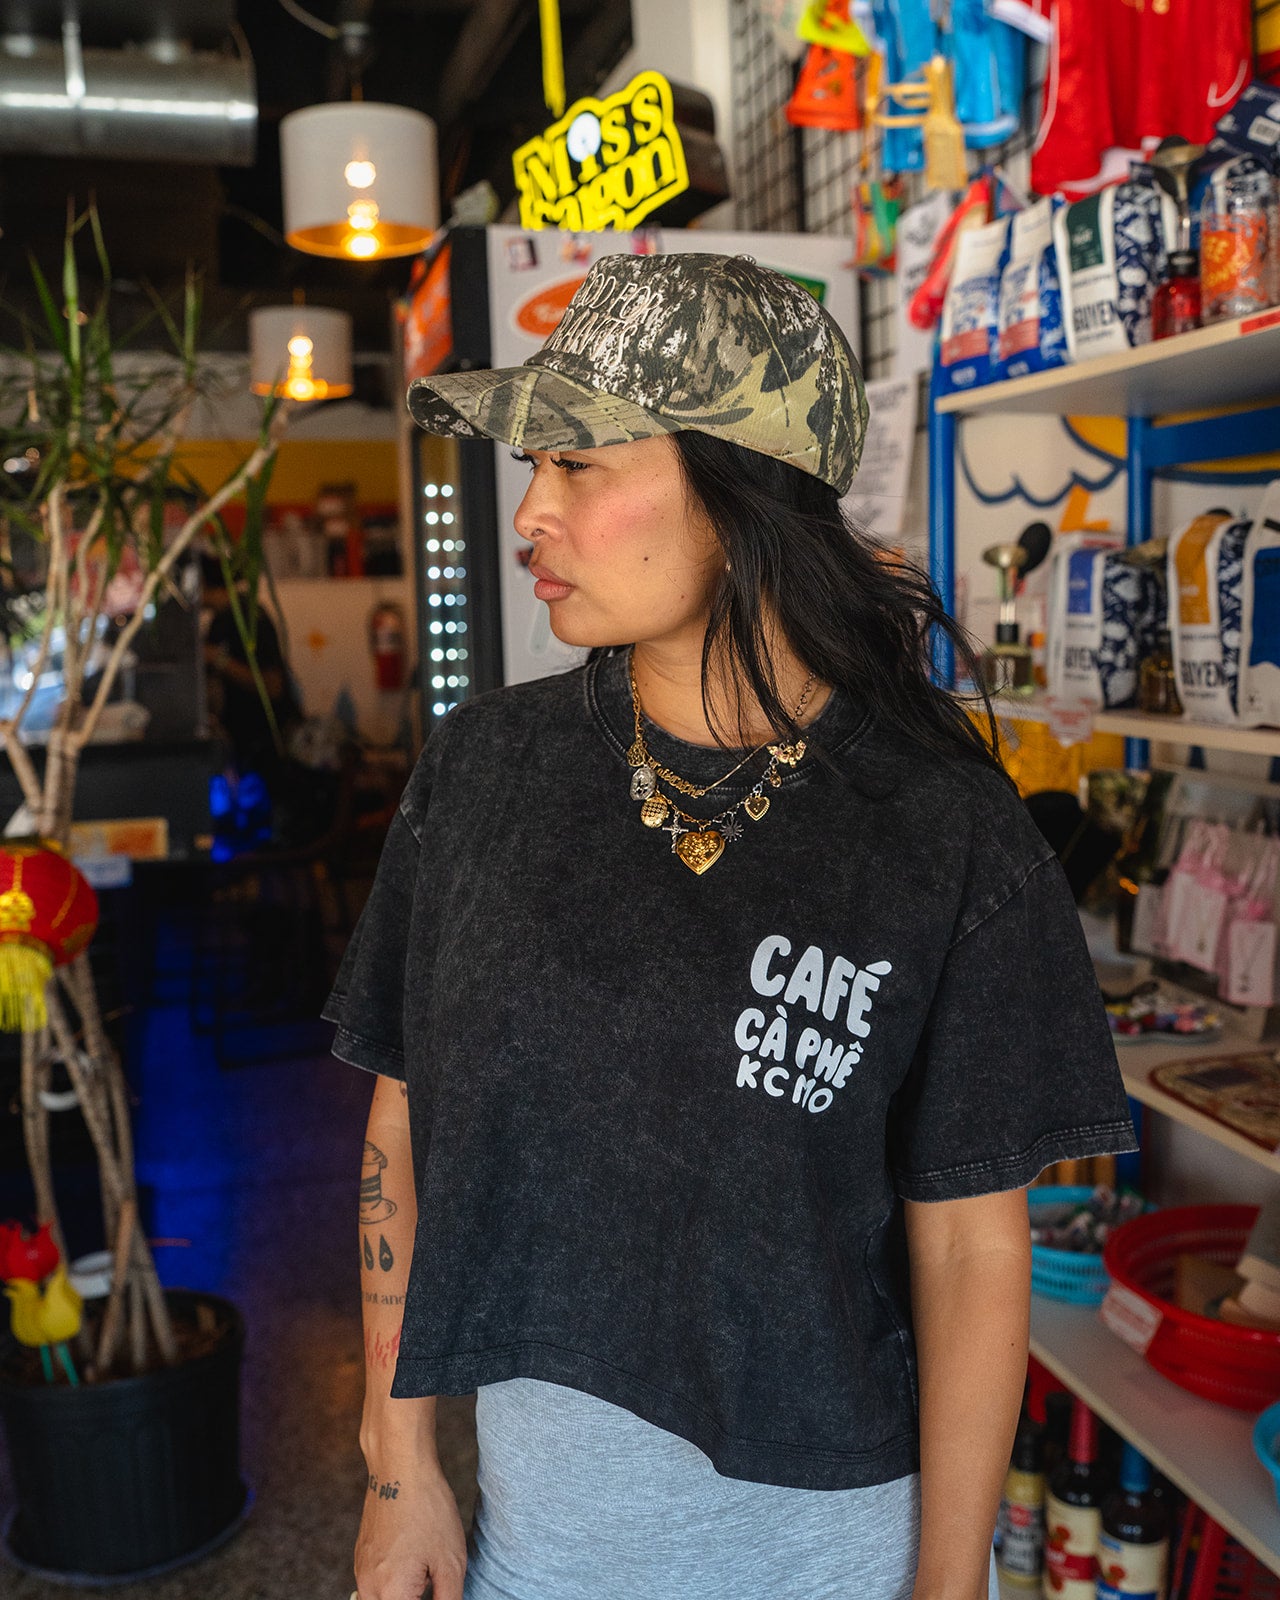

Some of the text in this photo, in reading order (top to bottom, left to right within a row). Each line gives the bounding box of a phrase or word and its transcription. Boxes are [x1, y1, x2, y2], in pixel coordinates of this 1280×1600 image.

[750, 934, 893, 1039] CAFÉ
[734, 1004, 864, 1089] CÀ PHÊ
